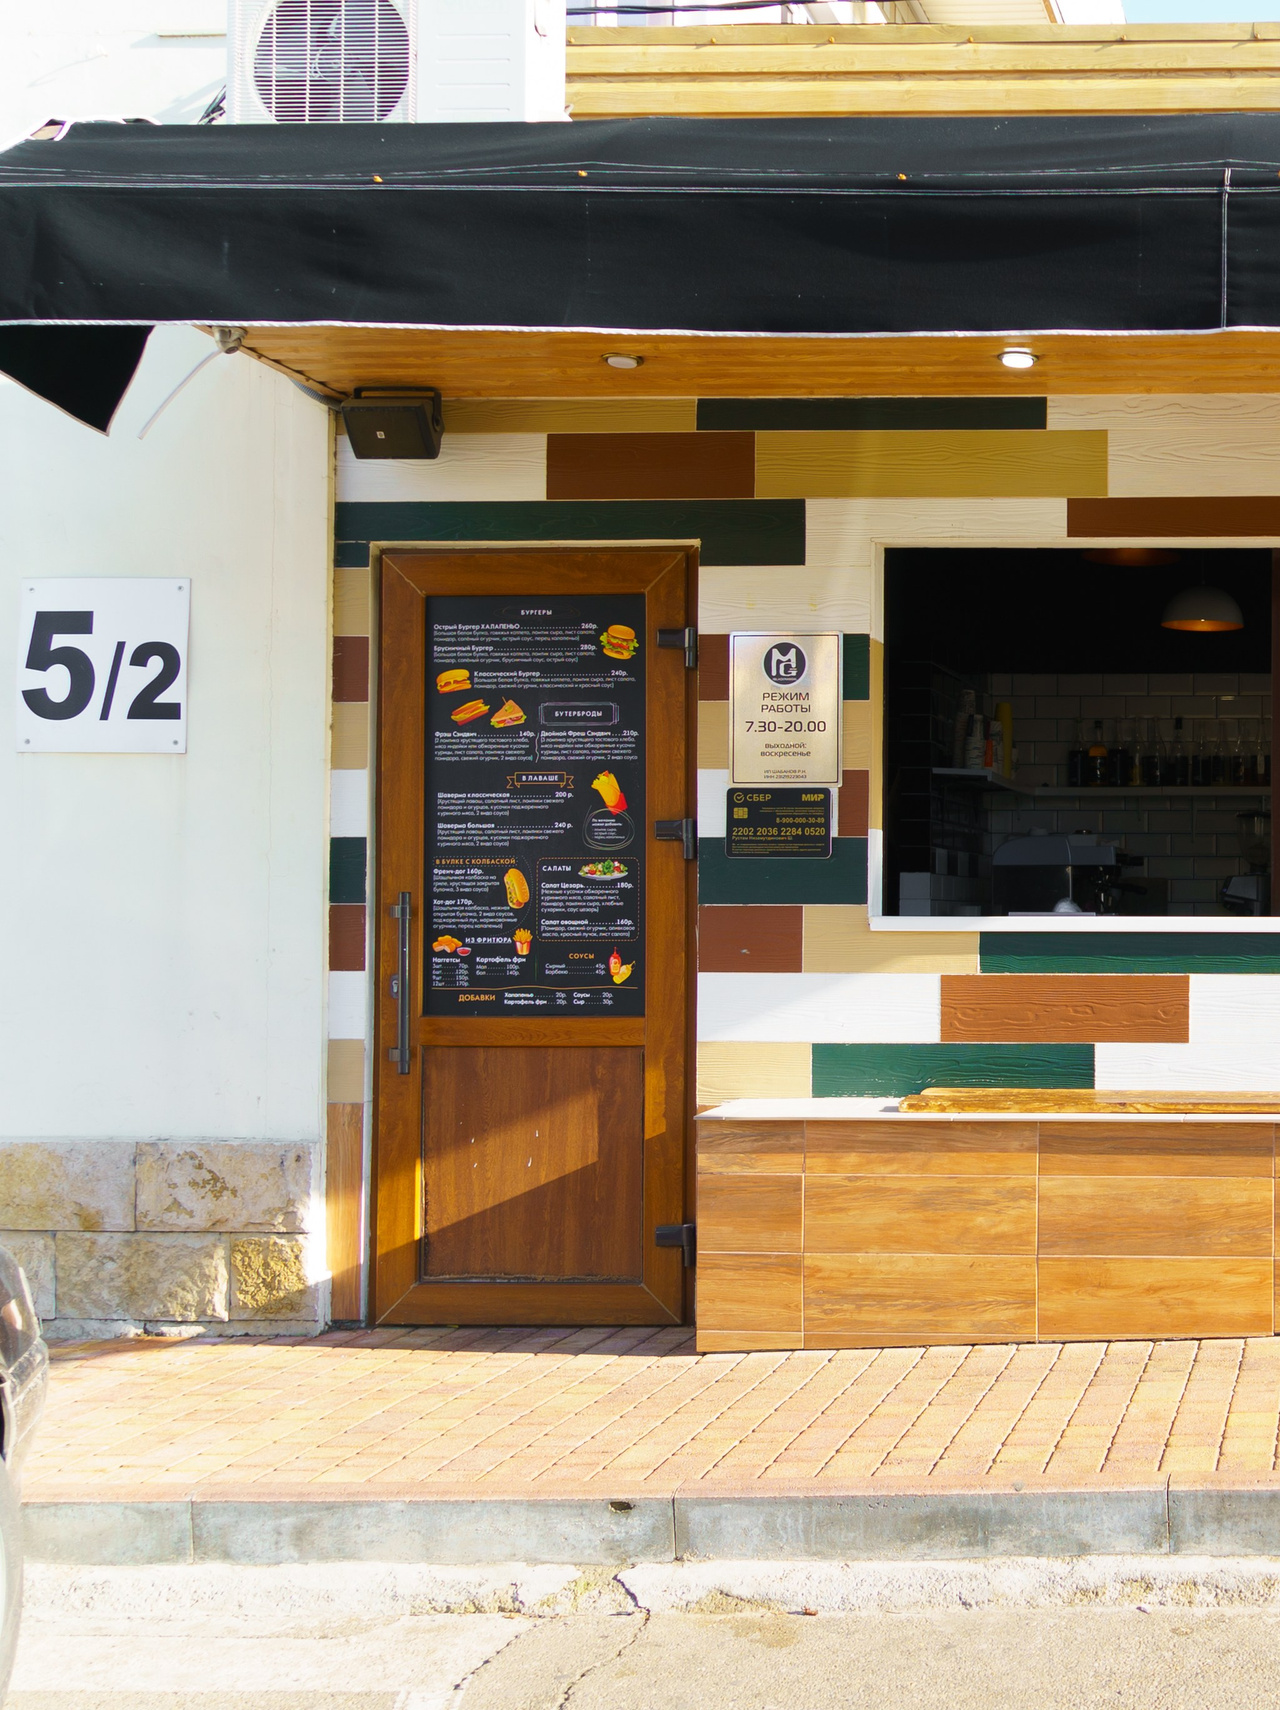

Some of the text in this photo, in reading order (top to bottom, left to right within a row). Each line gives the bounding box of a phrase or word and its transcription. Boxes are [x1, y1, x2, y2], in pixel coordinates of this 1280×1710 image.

[472, 645, 493, 653] Бургер
[21, 610, 182, 721] 5/2
[763, 692, 809, 701] РЕЖИМ
[761, 704, 810, 713] РАБОТЫ
[746, 721, 826, 732] 7.30-20.00
